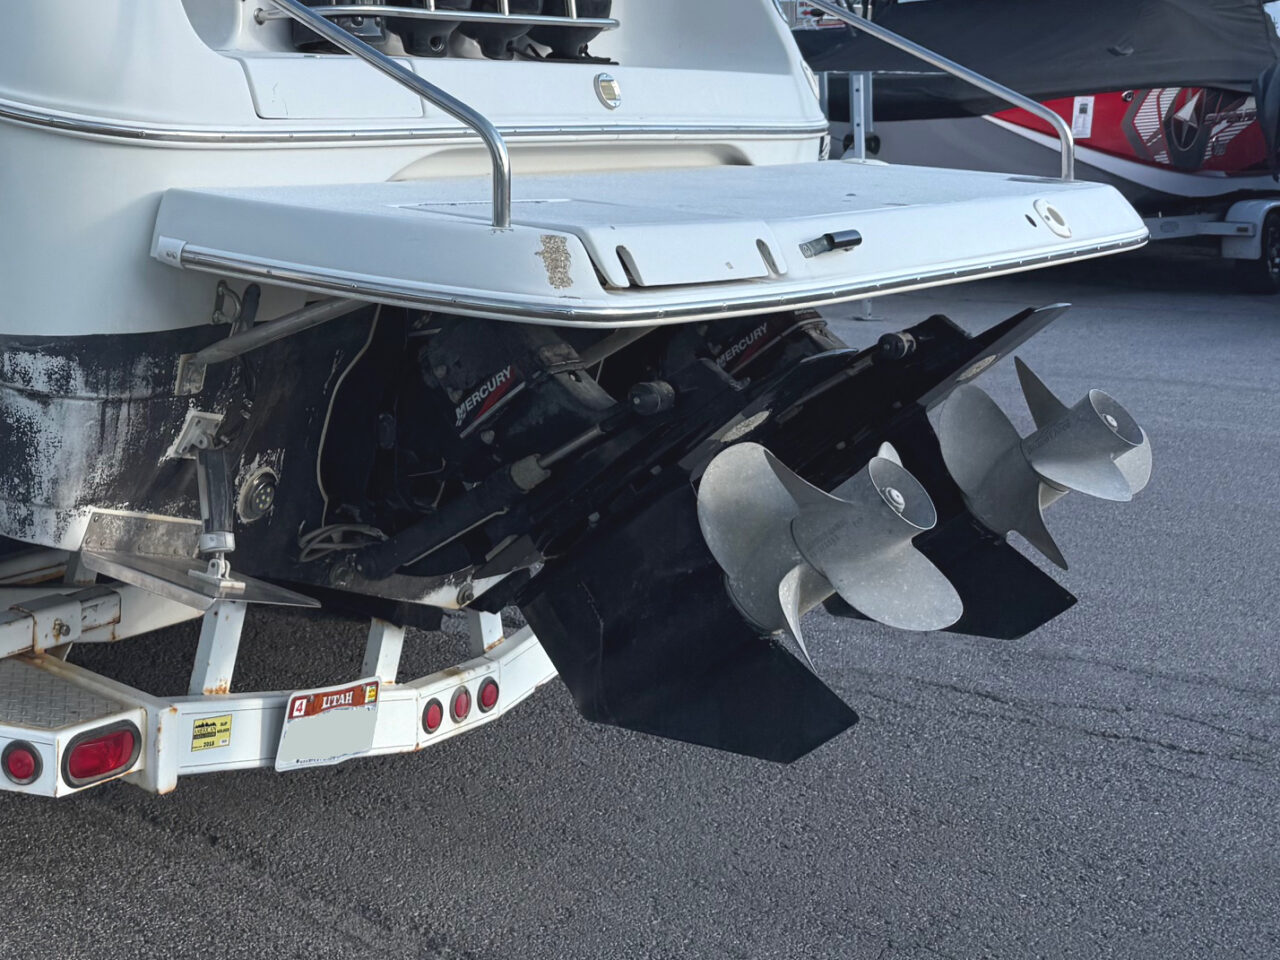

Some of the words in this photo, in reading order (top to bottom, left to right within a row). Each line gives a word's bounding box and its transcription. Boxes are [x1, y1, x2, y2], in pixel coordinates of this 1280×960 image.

[715, 322, 769, 369] MERCURY
[455, 365, 511, 421] MERCURY
[295, 702, 304, 714] 4
[321, 691, 353, 709] UTAH
